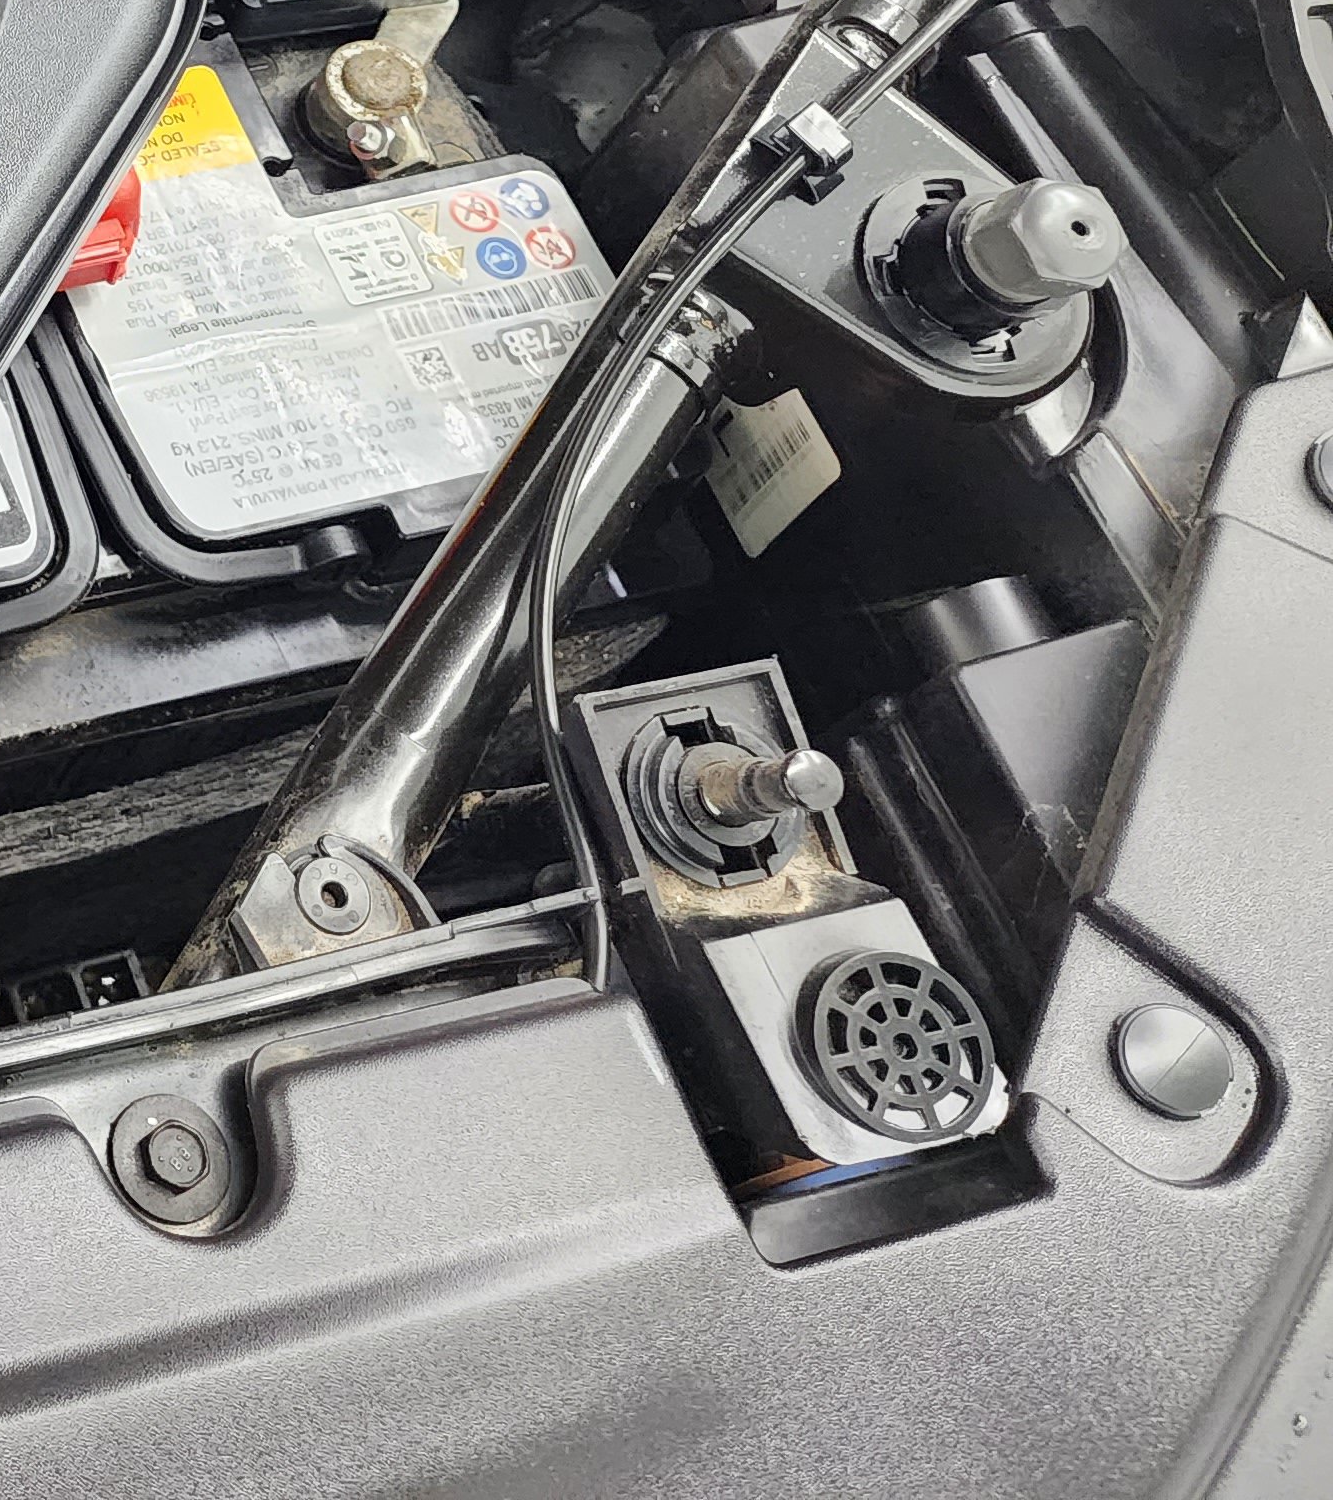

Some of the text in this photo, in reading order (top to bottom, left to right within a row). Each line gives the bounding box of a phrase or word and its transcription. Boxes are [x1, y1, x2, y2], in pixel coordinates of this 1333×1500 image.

[159, 130, 183, 146] DO
[164, 320, 209, 337] Legal:
[383, 396, 412, 413] RC
[168, 439, 195, 458] kg
